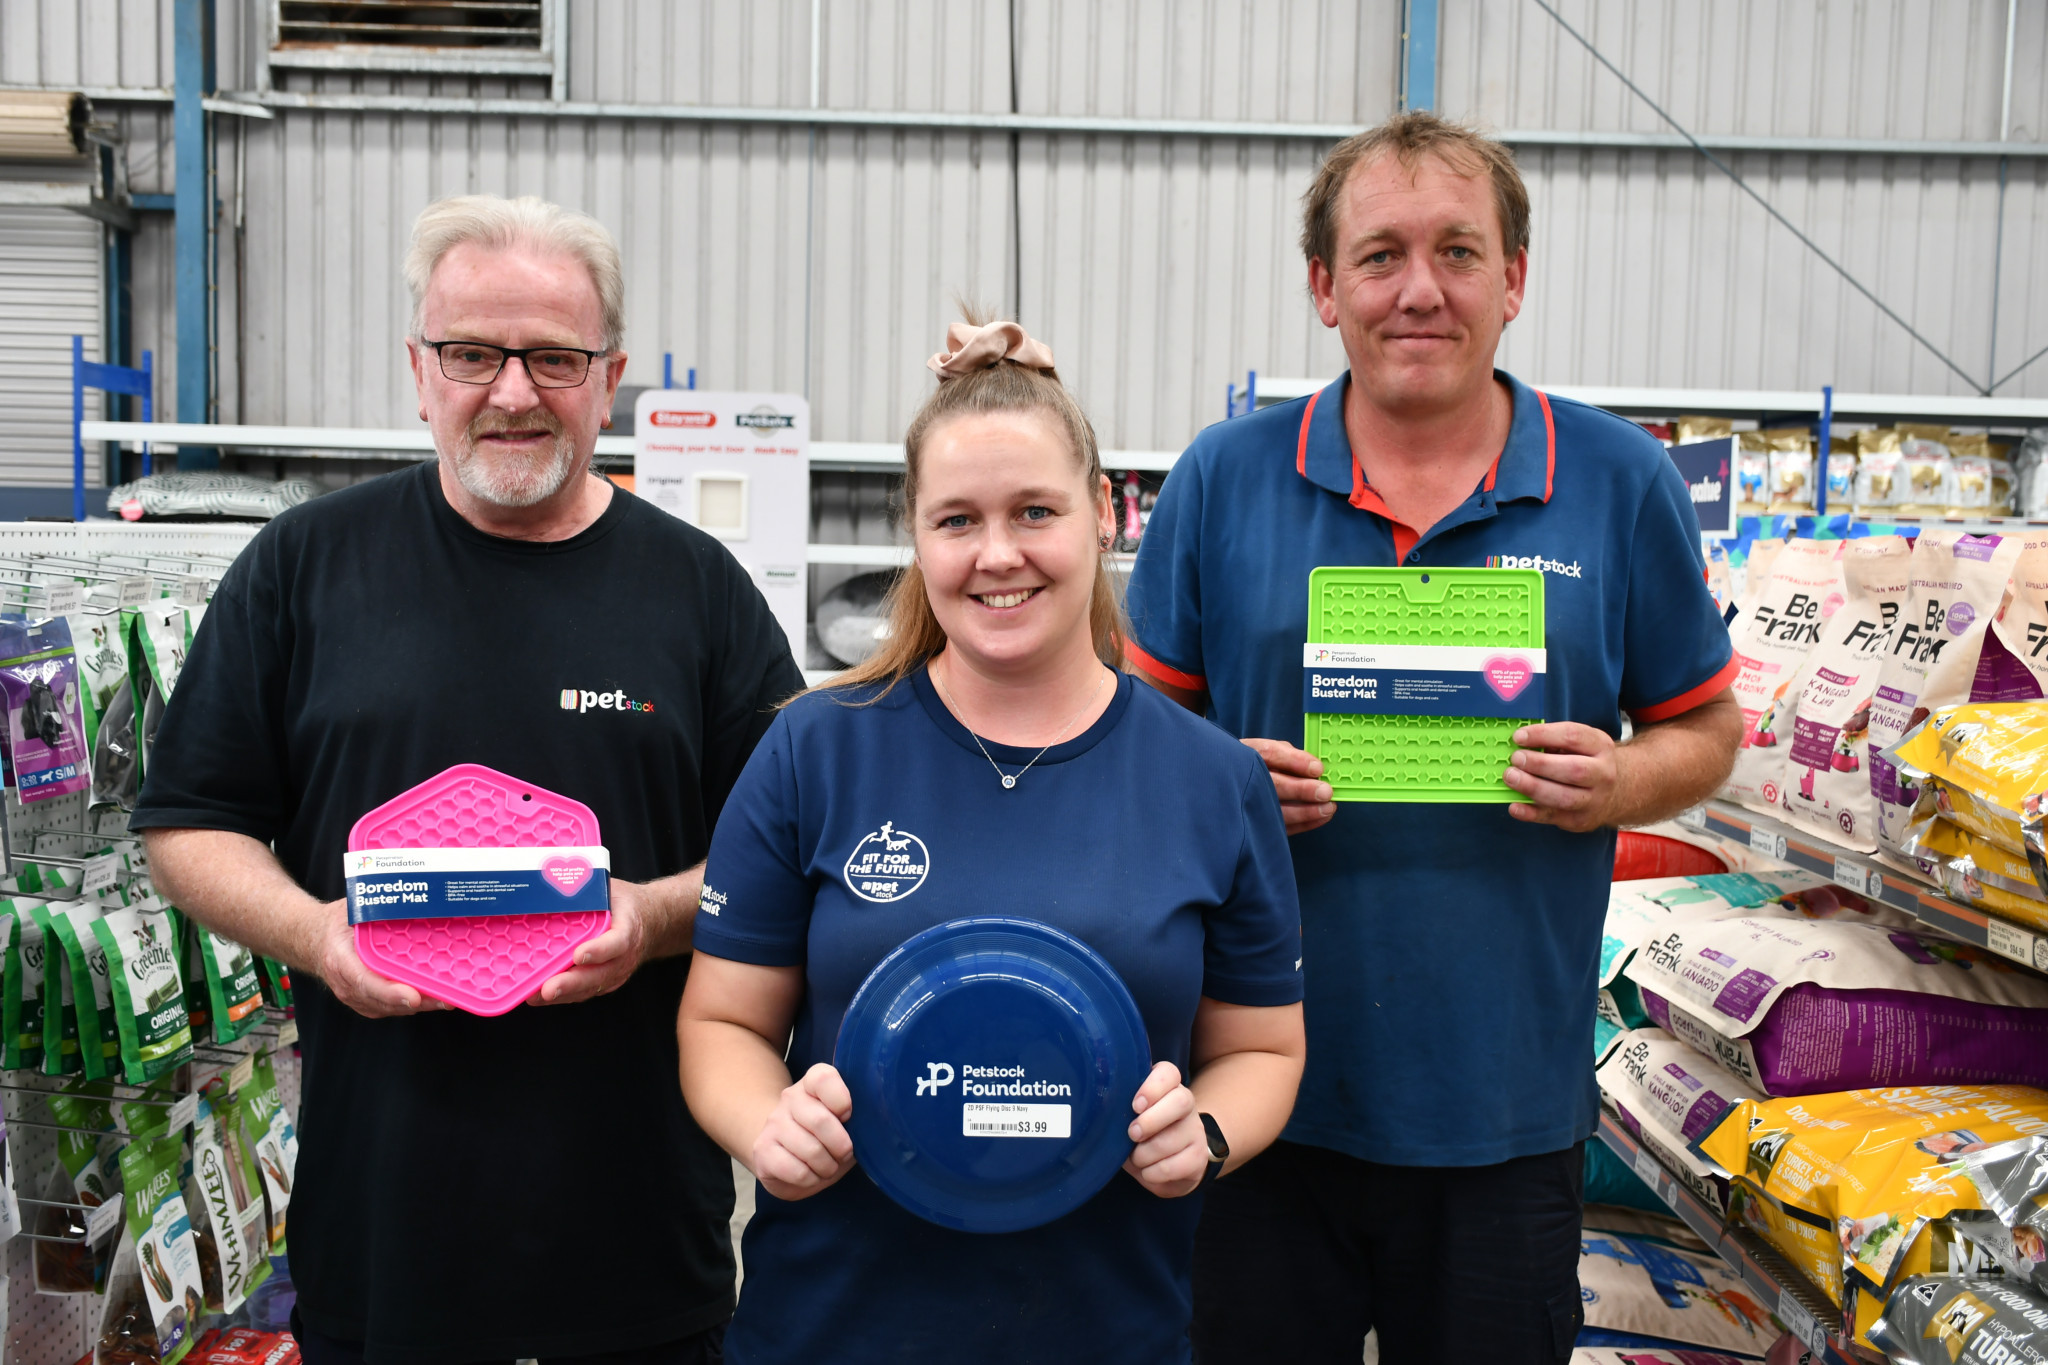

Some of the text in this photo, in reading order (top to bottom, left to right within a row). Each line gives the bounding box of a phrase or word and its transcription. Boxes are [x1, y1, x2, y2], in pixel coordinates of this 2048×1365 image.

[656, 412, 788, 427] Staywell PetSafe
[648, 476, 682, 486] Original
[2024, 542, 2037, 550] OOD
[1784, 593, 1818, 619] Be
[1925, 599, 1946, 632] Be
[1747, 606, 1821, 643] Frank
[1331, 655, 1376, 663] Foundation
[1312, 674, 1378, 688] Boredom
[579, 689, 655, 714] petstock
[1312, 687, 1377, 699] Buster Mat
[1878, 689, 1892, 698] ADULT
[55, 766, 76, 780] S/M
[375, 859, 426, 868] Foundation
[862, 853, 910, 865] FIT FOR
[849, 864, 924, 875] THE FUTURE
[2004, 861, 2032, 880] 9KG NET
[355, 879, 428, 896] Boredom
[870, 881, 899, 894] pet
[876, 891, 893, 899] stock
[356, 893, 428, 907] Buster Mat
[1663, 933, 1683, 953] Be
[131, 942, 172, 981] Greenie
[1645, 940, 1682, 974] Frank
[151, 1003, 185, 1029] ORIGINAL
[1632, 1041, 1649, 1062] Be
[962, 1064, 1025, 1078] Petstock
[962, 1079, 1072, 1097] Foundation
[1018, 1121, 1047, 1133] $3.99
[1783, 1150, 1813, 1179] TURKEY,
[1782, 1167, 1816, 1193] SARDIN
[1847, 1175, 1866, 1194] FREE
[201, 1148, 242, 1297] WHIMZEES
[1999, 1291, 2033, 1311] FOOD
